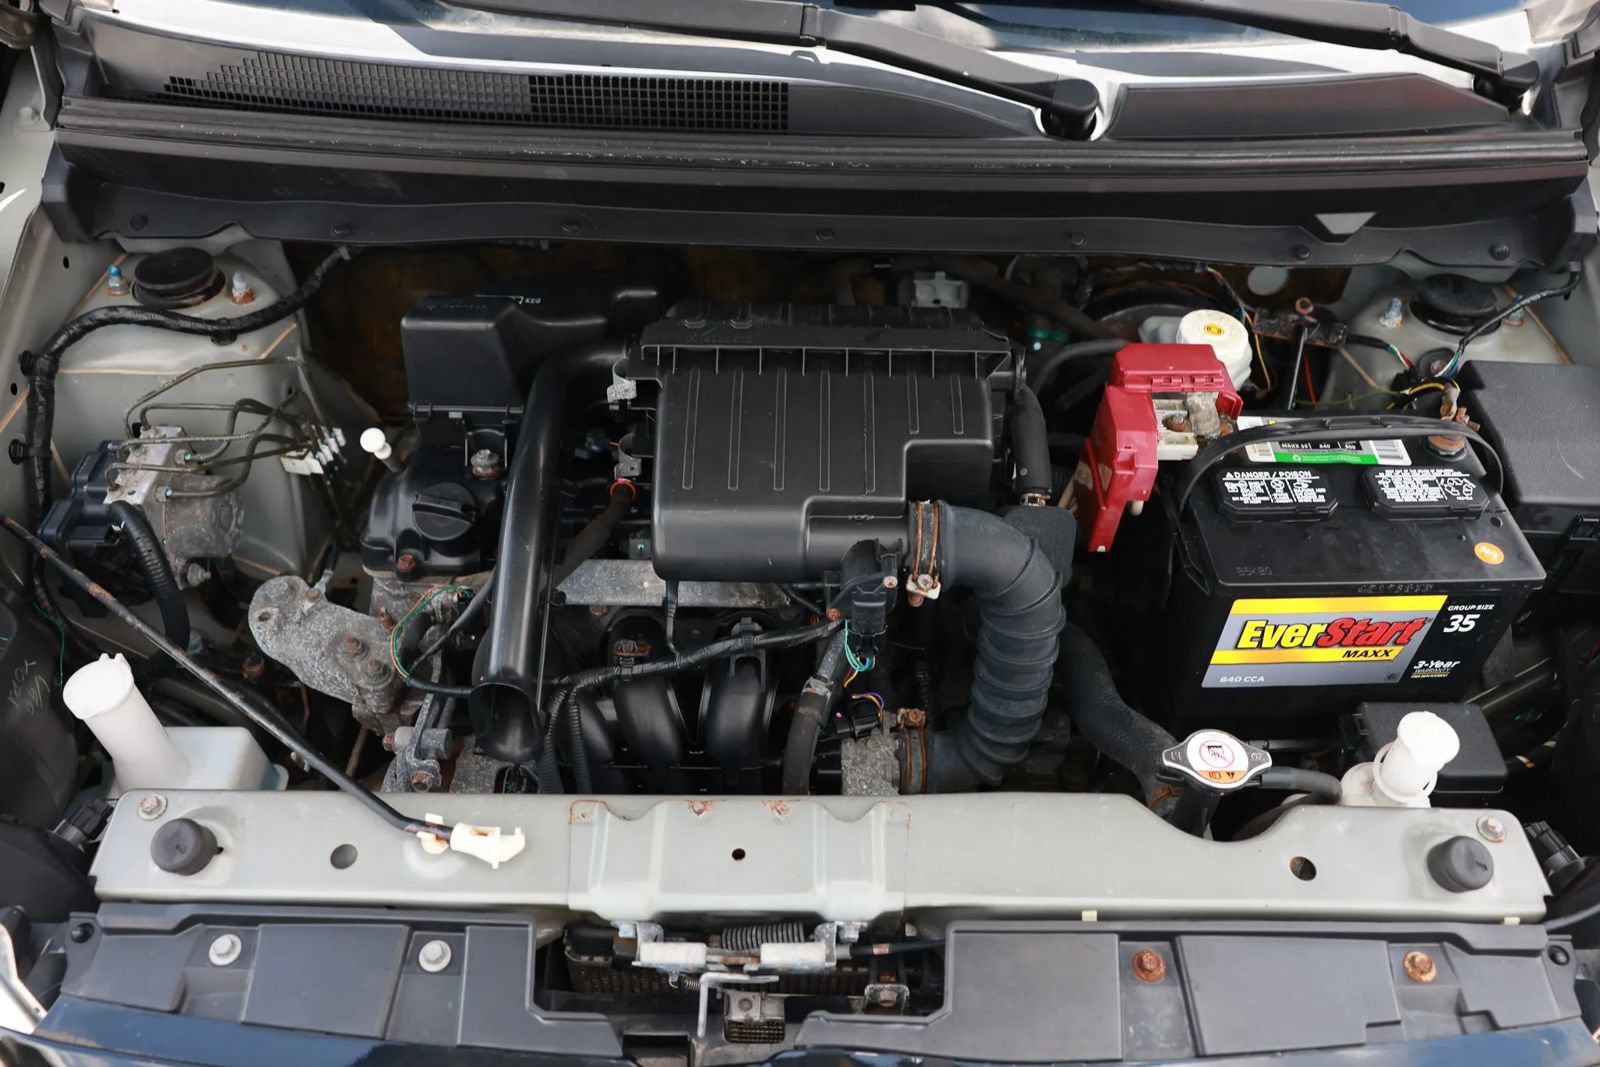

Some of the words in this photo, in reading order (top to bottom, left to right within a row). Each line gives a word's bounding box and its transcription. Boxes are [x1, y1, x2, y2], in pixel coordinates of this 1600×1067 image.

[1233, 471, 1270, 479] DANGER
[1278, 470, 1312, 478] POISON
[1443, 613, 1480, 633] 35
[1236, 617, 1426, 649] EverStart
[1342, 649, 1394, 659] MAXX
[1413, 660, 1460, 669] 3-Year
